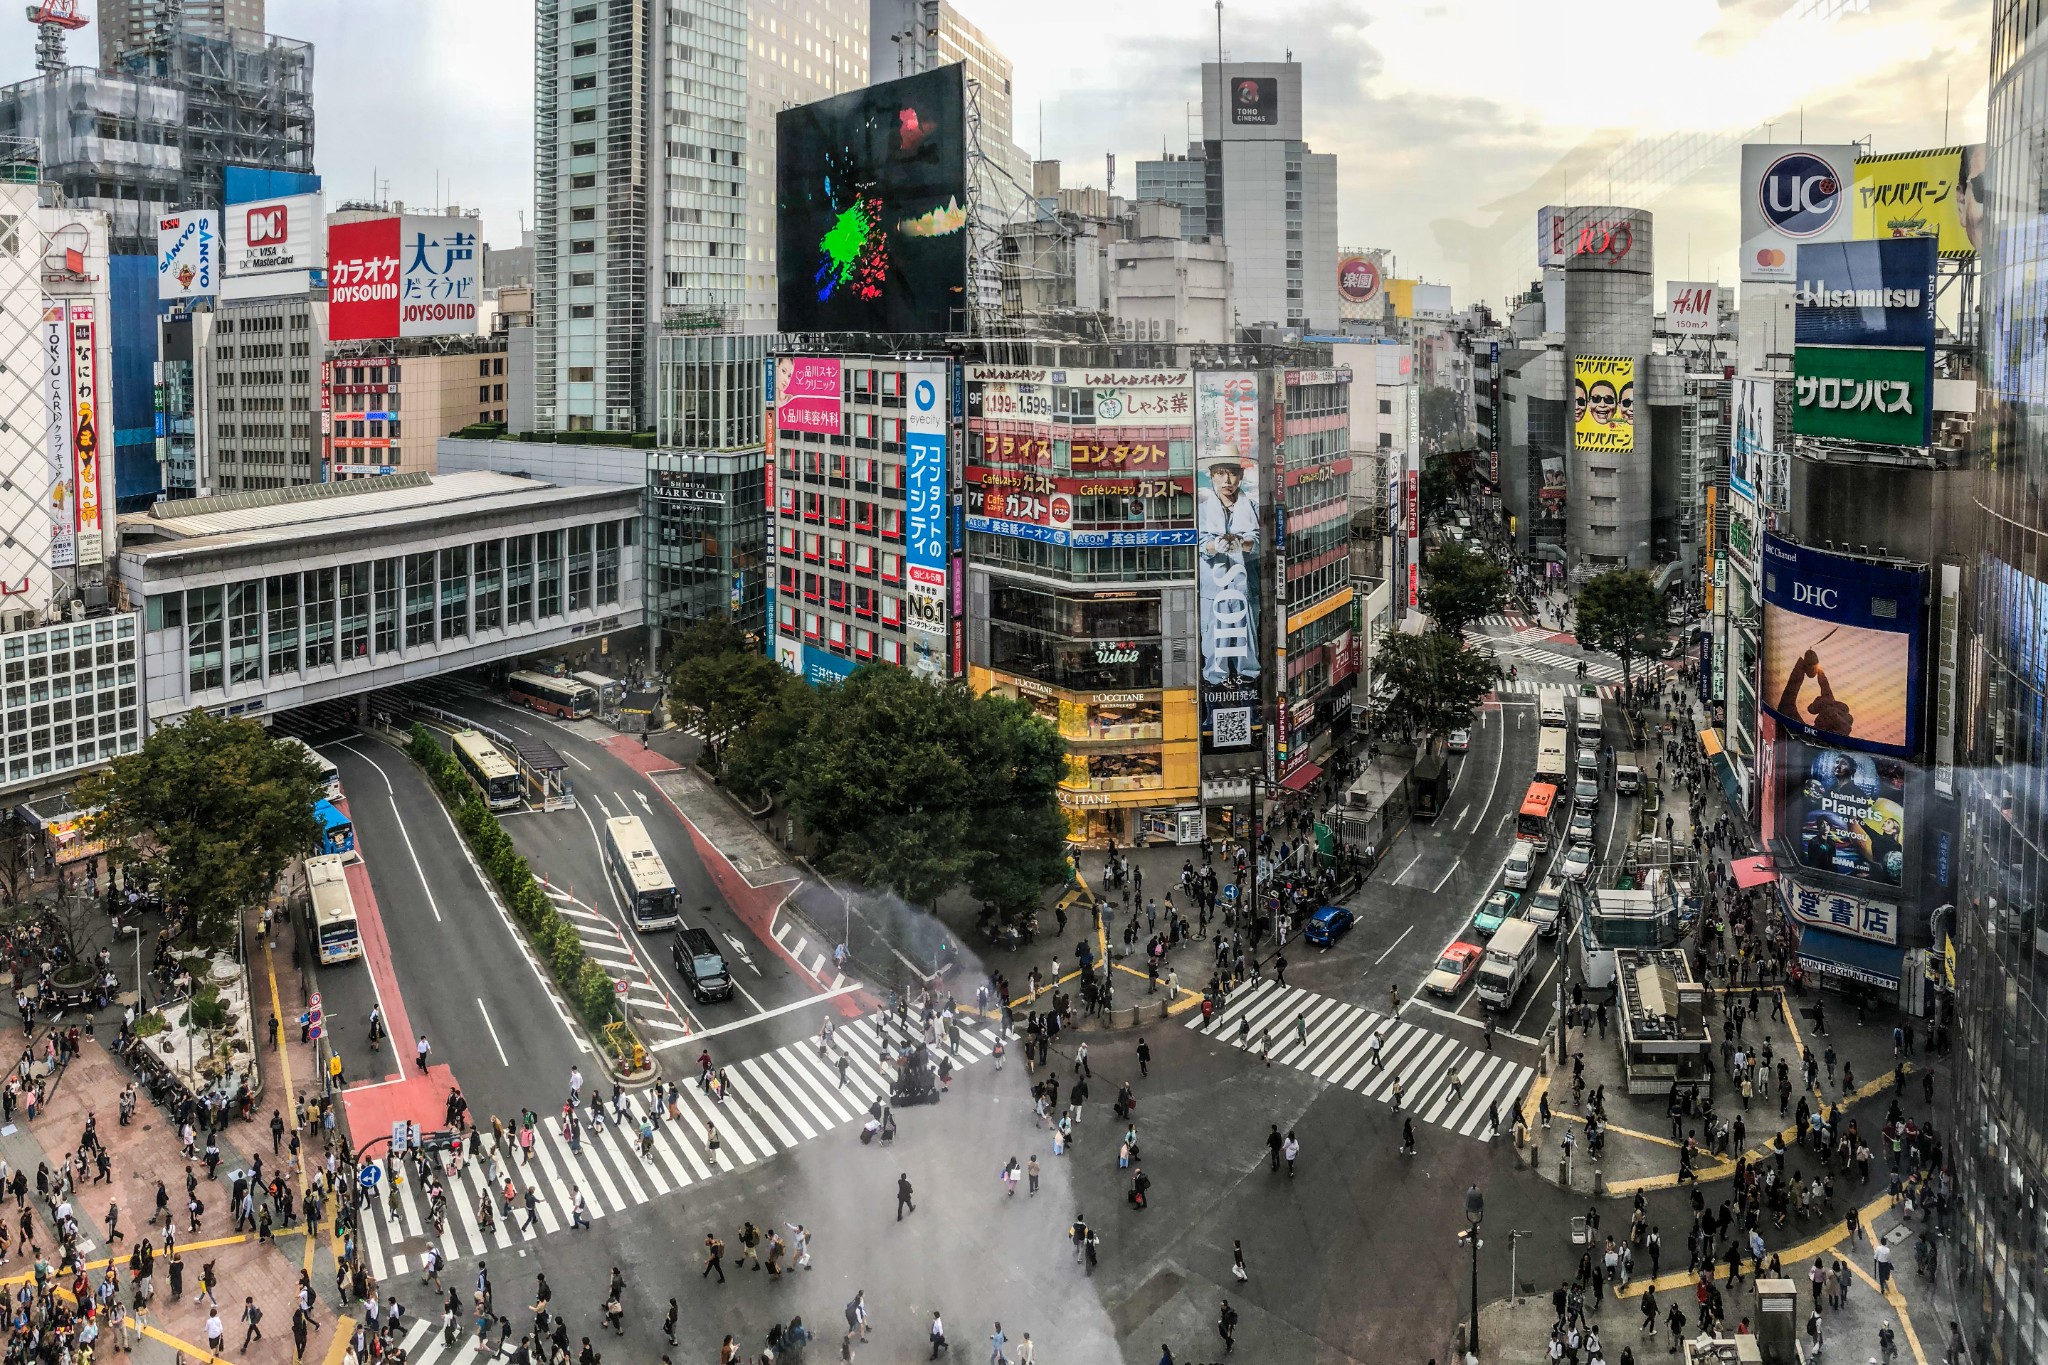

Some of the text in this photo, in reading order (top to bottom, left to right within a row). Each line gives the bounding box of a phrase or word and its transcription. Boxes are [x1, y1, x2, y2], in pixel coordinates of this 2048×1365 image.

[1860, 180, 1953, 209] ヤバババーン
[251, 210, 282, 242] DC
[160, 222, 196, 273] SANKYO
[199, 218, 213, 287] SANKYO
[246, 249, 258, 258] DC
[259, 247, 277, 257] VISA
[405, 232, 476, 275] 大声
[1577, 228, 1632, 266] 109
[240, 255, 294, 269] DC MasterCard
[332, 256, 400, 285] カラオケ
[1343, 272, 1373, 288] 楽園
[332, 283, 398, 303] JOYSOUND
[1673, 288, 1712, 316] H&M
[1793, 279, 1920, 309] Hisamitsu
[1928, 274, 1936, 320] サロンパス
[403, 304, 476, 322] JOYSOUND
[49, 324, 60, 376] TOKYU
[360, 358, 386, 366] JOYSOUND
[804, 365, 838, 378] 品川スキン
[1576, 361, 1632, 376] ヤバババーン
[973, 368, 1046, 381] しゃぶしゃぶバイキング
[1085, 373, 1187, 385] しゃぶしゃぶバイキング
[804, 379, 836, 391] クリニック
[52, 379, 62, 422] CARD
[970, 392, 982, 404] 9F
[1128, 392, 1188, 415] しゃぶ葉
[1796, 375, 1913, 415] サロンパス
[787, 407, 839, 428] 品川美容外科
[910, 414, 940, 427] eyecity
[1220, 379, 1238, 444] Sazabys
[76, 345, 98, 527] なにわうまいもん市
[1240, 406, 1254, 469] Limited
[1576, 432, 1632, 446] ヤバババーン
[985, 437, 1051, 459] プライス
[1072, 444, 1166, 464] コンタクト
[653, 487, 726, 500] MARK CITY
[670, 481, 705, 489] SHIBUYA
[1023, 474, 1056, 494] ガスト
[1138, 480, 1182, 498] ガスト
[910, 445, 927, 555] アイシティ
[929, 446, 942, 558] コンタクトの
[970, 491, 984, 506] 7F
[987, 494, 1004, 505] Café
[1005, 494, 1047, 520] ガスト
[1054, 508, 1069, 516] ガスト
[1409, 497, 1417, 531] TaxFree
[969, 517, 987, 529] AEON
[993, 521, 1051, 540] 英会話イーオン
[1077, 531, 1196, 546] AEON 英会話イーオン
[1765, 543, 1797, 562] DHC Channel
[913, 569, 942, 584] 当ビル5階
[1793, 581, 1838, 611] DHC
[908, 592, 945, 626] No.1
[1212, 564, 1248, 673] SOIL
[908, 618, 945, 633] コンタクトショップ
[1095, 649, 1139, 663] Ushi8
[1336, 651, 1349, 669] アコム
[1015, 677, 1052, 695] L'OCCITANE
[1093, 693, 1145, 702] L'OCCITANE
[1204, 689, 1258, 703] 10月10日発売
[1332, 690, 1351, 715] LUSH
[1938, 672, 1951, 738] neon
[1804, 726, 1818, 737] DHC
[1830, 790, 1866, 805] teamLab
[1822, 797, 1882, 822] Planets
[1839, 815, 1865, 826] TOKYO
[1836, 828, 1868, 842] TOYOSU
[1832, 856, 1870, 872] DMM.com
